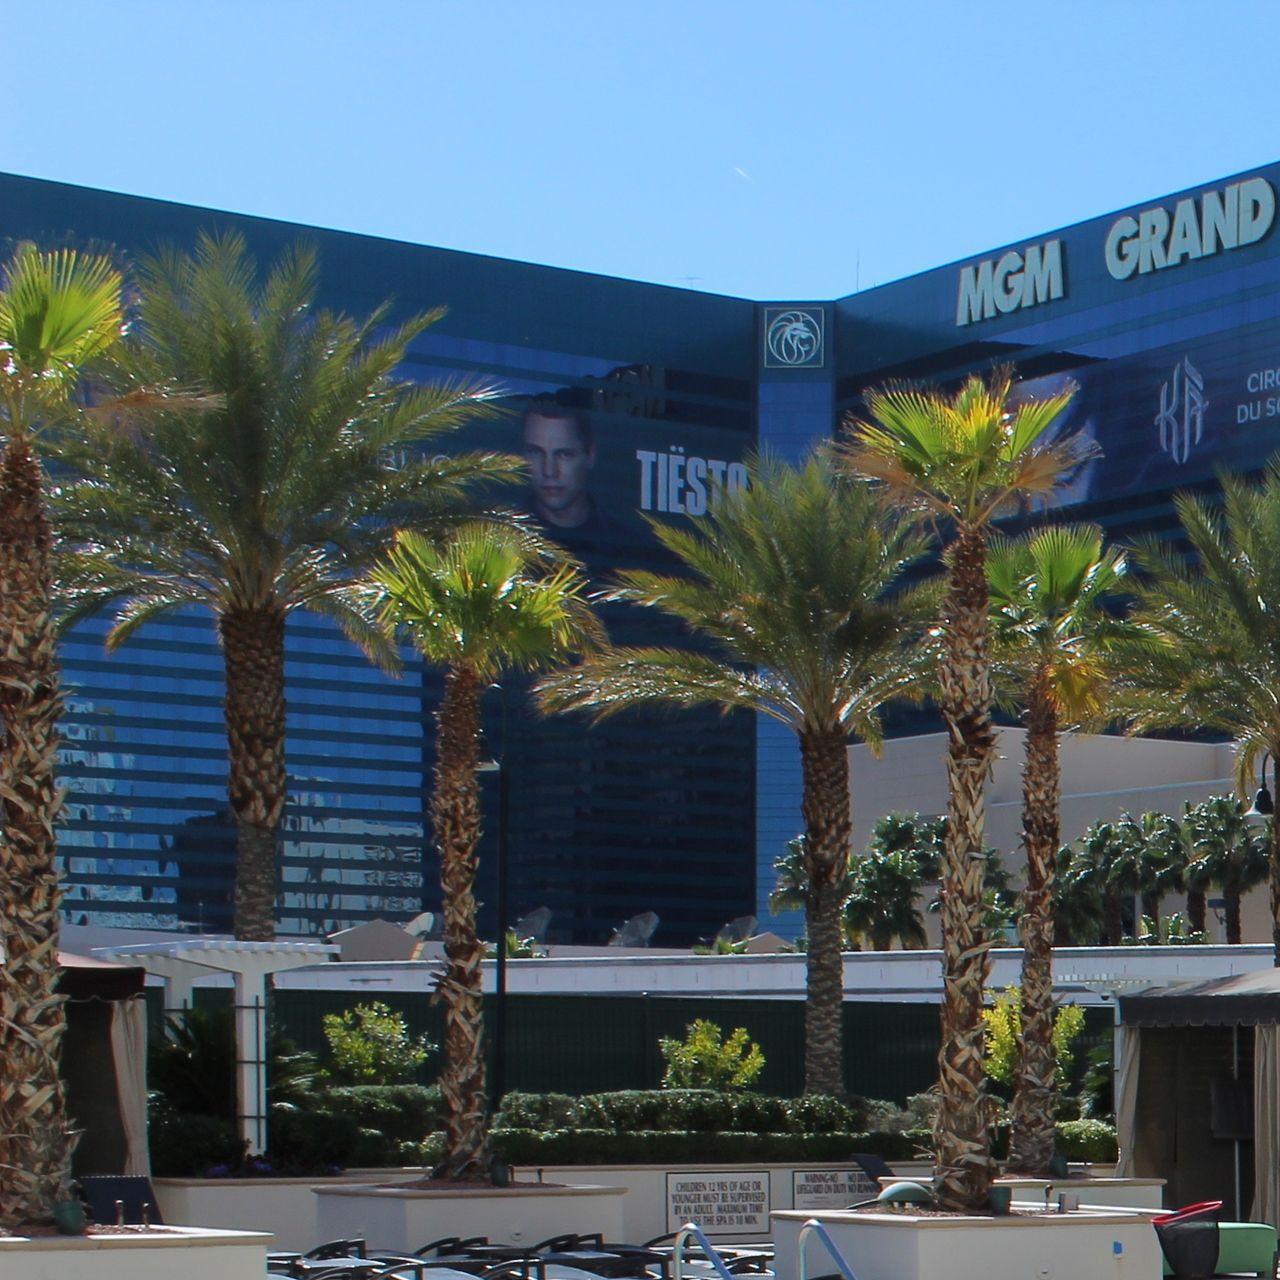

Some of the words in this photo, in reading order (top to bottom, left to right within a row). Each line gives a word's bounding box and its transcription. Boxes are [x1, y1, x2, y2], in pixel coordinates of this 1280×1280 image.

[957, 239, 1064, 326] MGM
[1105, 177, 1275, 280] GRAND
[1237, 402, 1261, 424] DU
[676, 1182, 707, 1192] CHILDREN
[729, 1181, 738, 1191] OF
[739, 1181, 751, 1191] AGE
[752, 1181, 761, 1191] OR
[671, 1193, 701, 1204] YOUNGER
[702, 1193, 719, 1203] MUST
[729, 1192, 766, 1202] SUPERVISED
